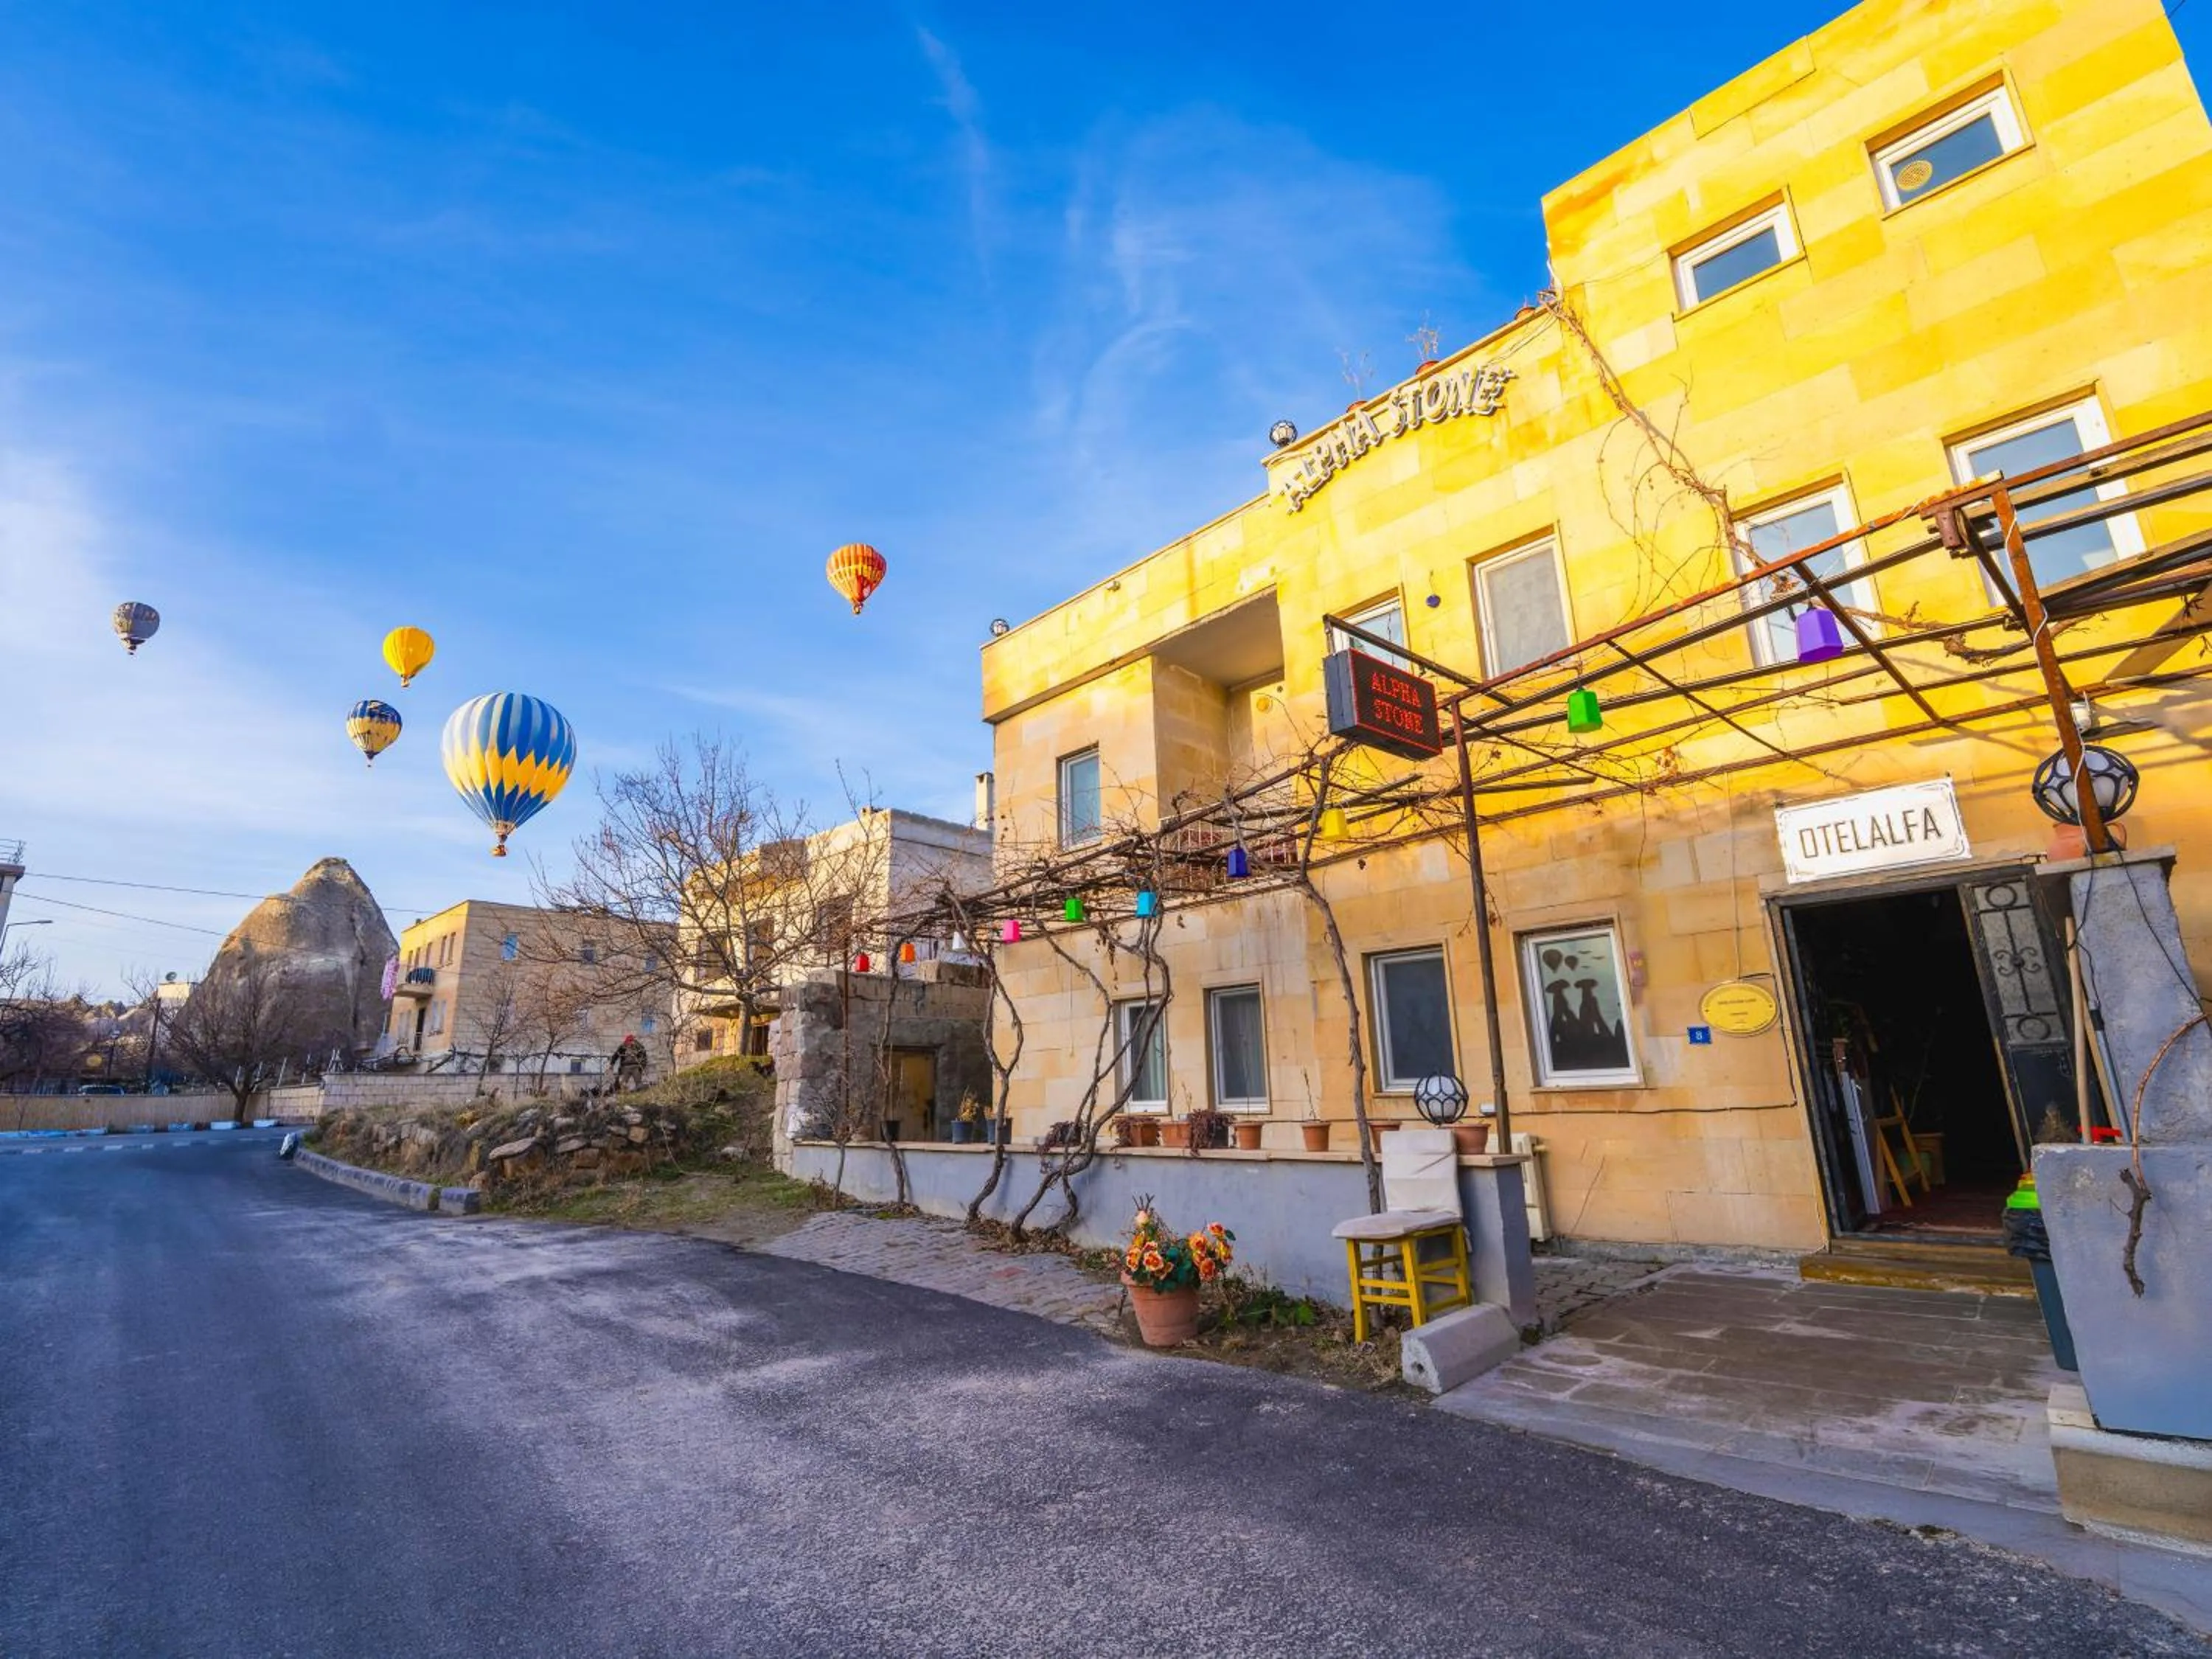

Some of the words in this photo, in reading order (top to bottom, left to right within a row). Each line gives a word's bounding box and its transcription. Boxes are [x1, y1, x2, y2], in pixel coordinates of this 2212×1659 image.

[1281, 408, 1382, 515] ALPHA
[1389, 366, 1516, 437] STONE
[1371, 672, 1422, 708] ALPHA
[1373, 698, 1424, 734] STONE
